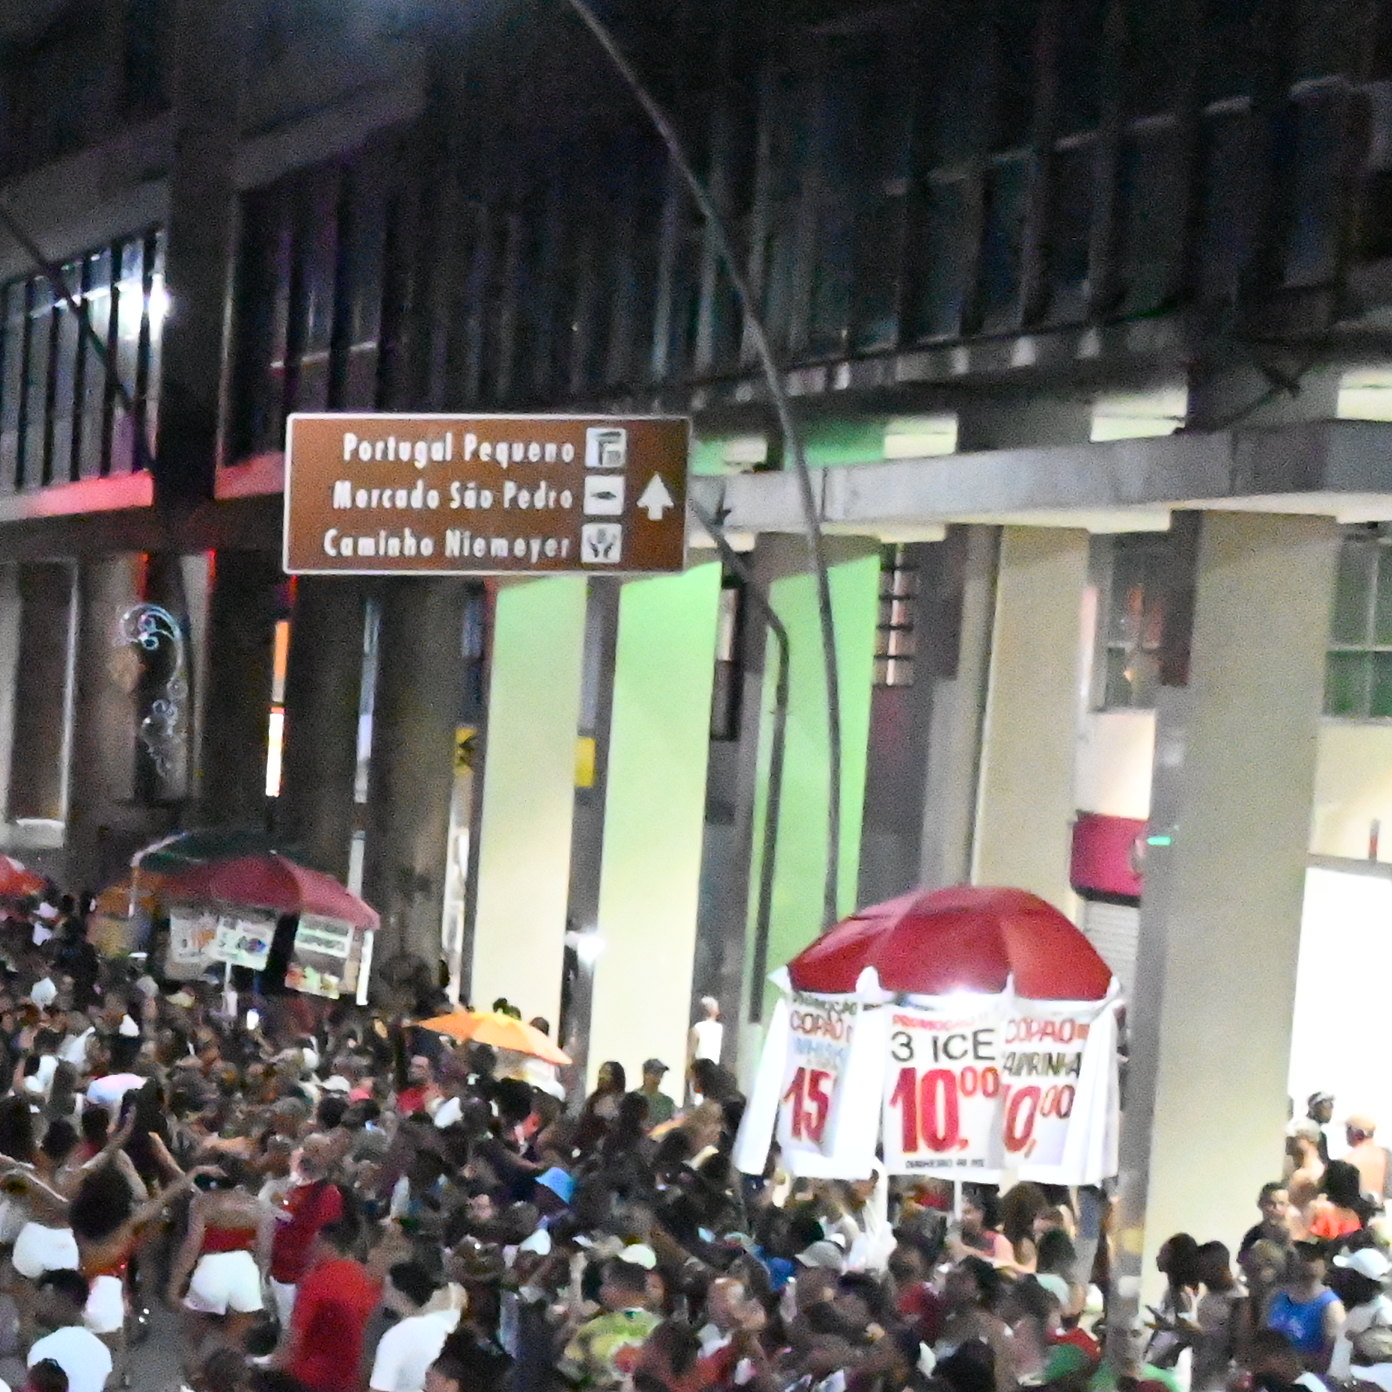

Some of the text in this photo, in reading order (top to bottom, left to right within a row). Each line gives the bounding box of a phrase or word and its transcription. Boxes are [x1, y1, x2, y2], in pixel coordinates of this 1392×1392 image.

[343, 432, 575, 468] Portugal Pequeno
[333, 480, 573, 510] Mercado São Pedro
[324, 527, 570, 563] Caminho Niemeyer
[891, 1029, 995, 1062] 3 ICE
